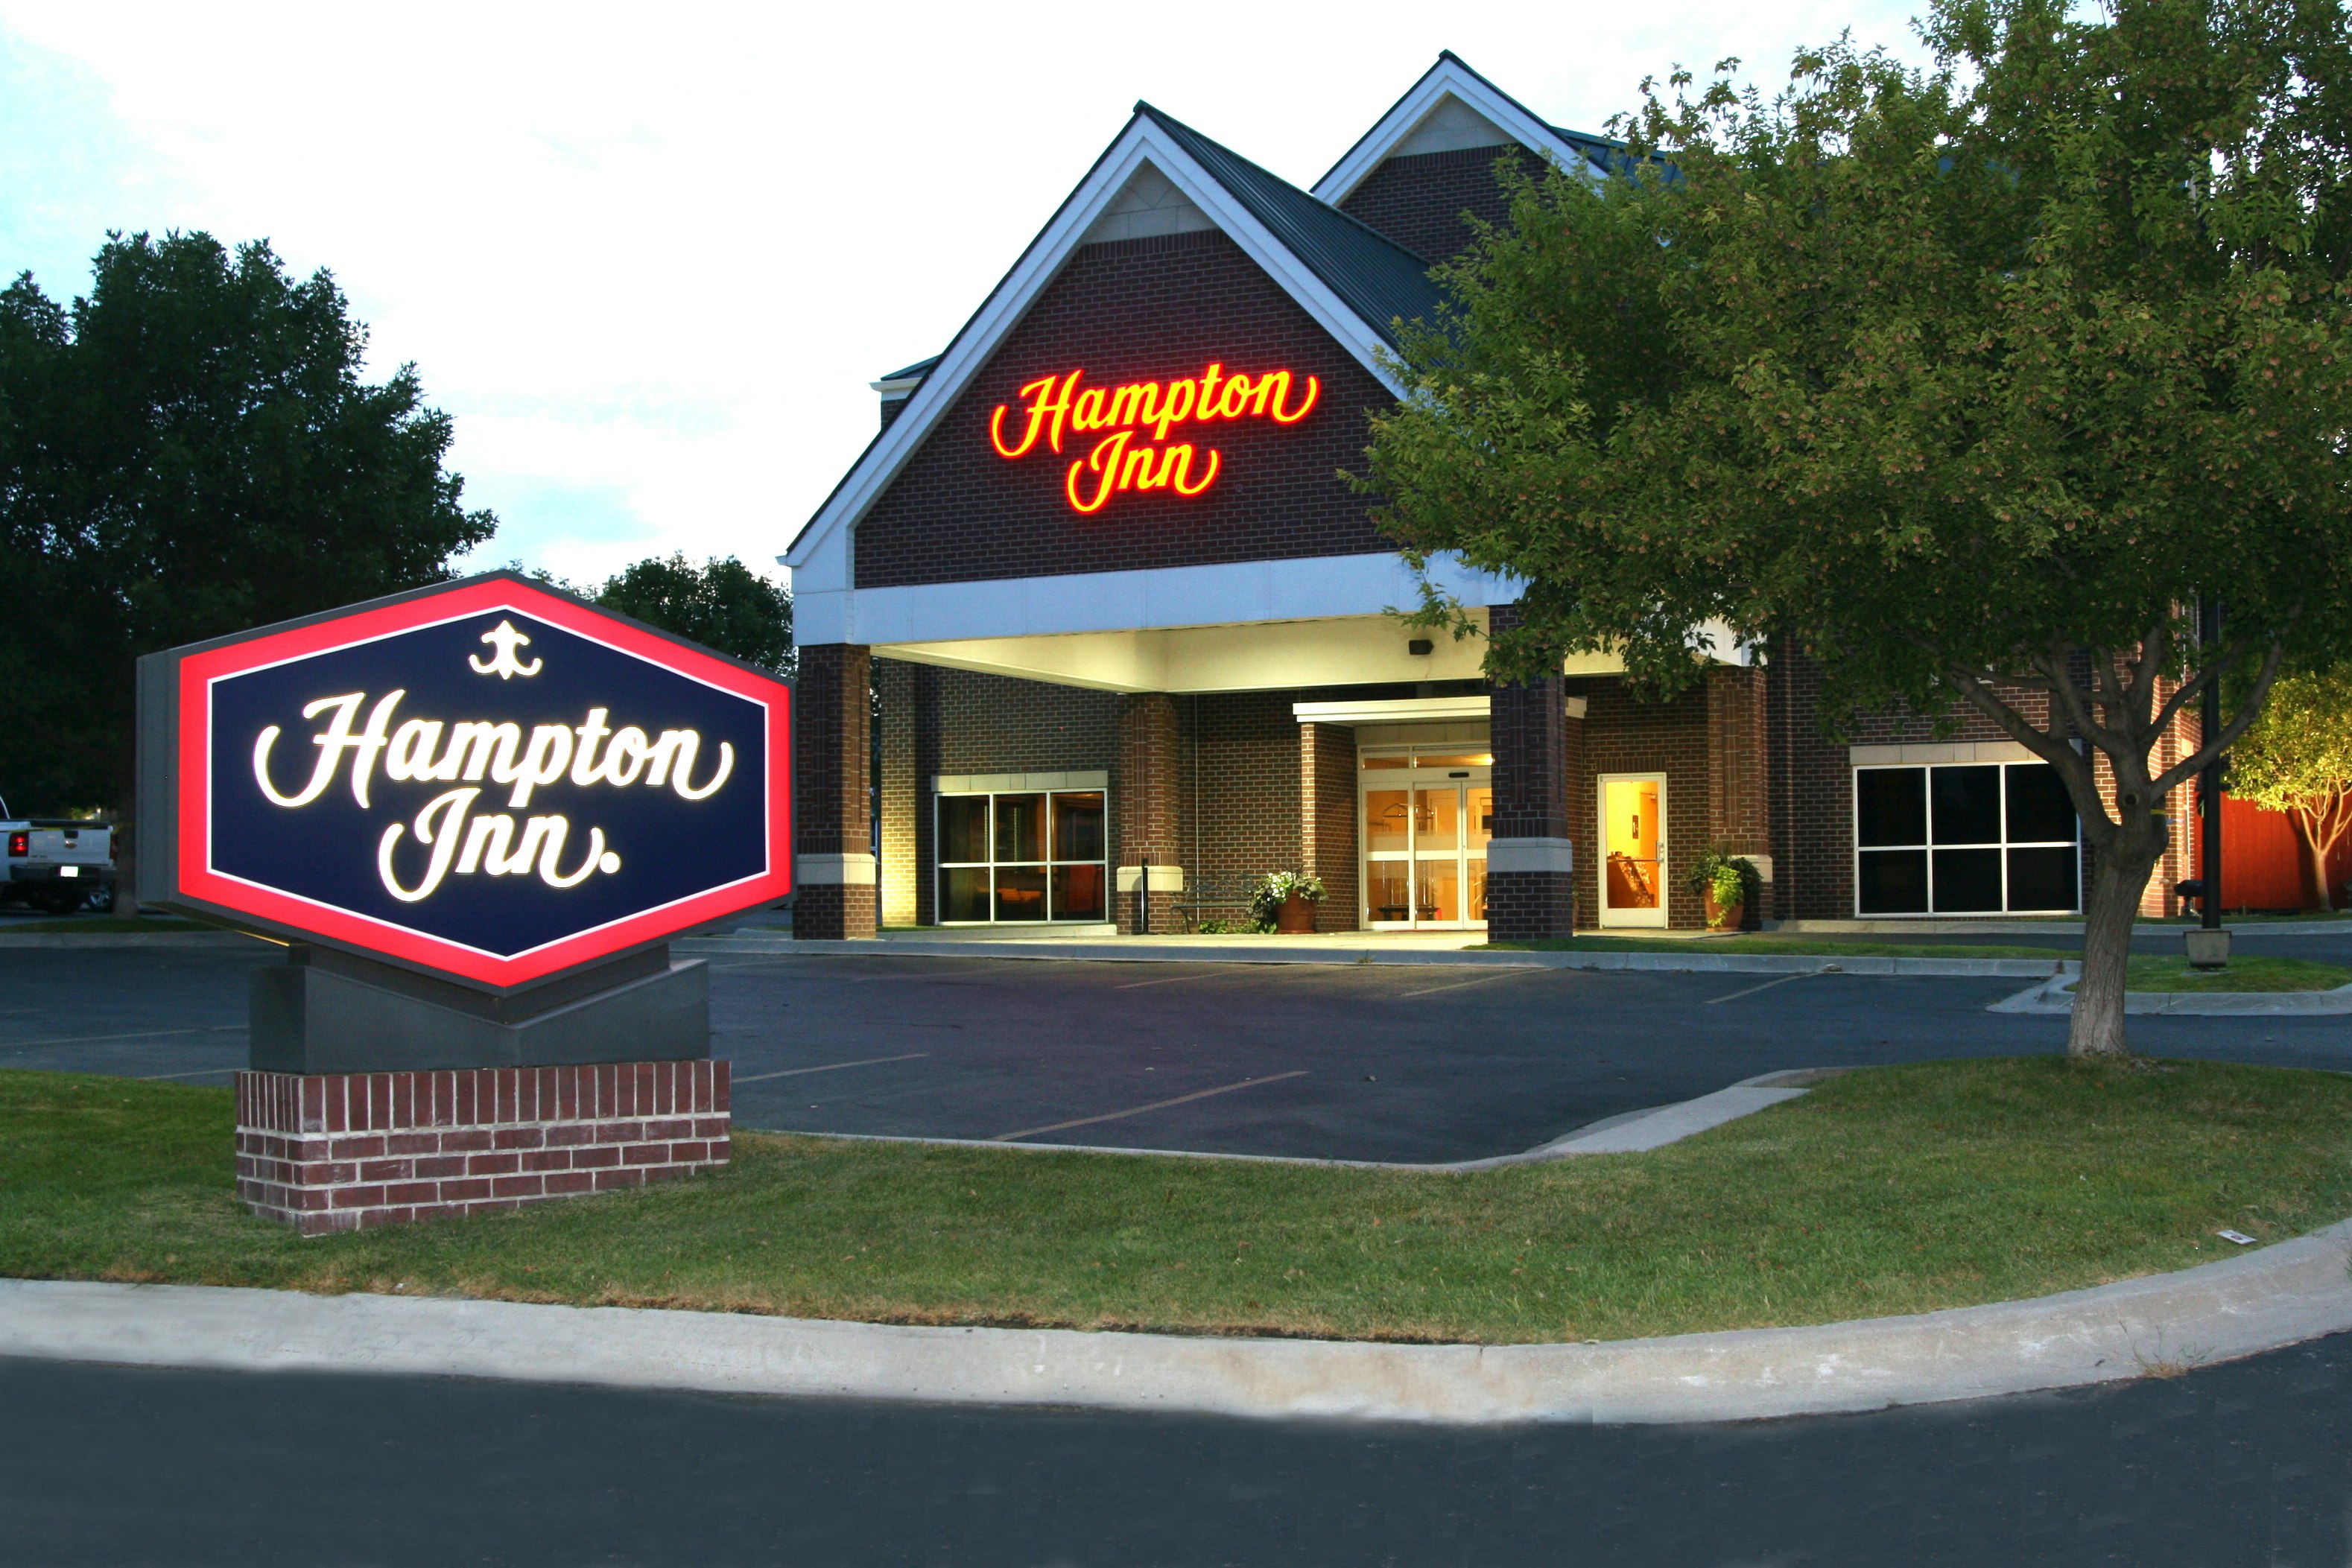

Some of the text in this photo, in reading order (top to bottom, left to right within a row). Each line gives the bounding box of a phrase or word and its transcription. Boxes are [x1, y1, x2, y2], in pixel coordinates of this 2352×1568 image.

[989, 362, 1321, 457] Hampton
[1065, 430, 1222, 514] Inn
[253, 688, 735, 810] Hampton
[377, 787, 606, 903] Inn
